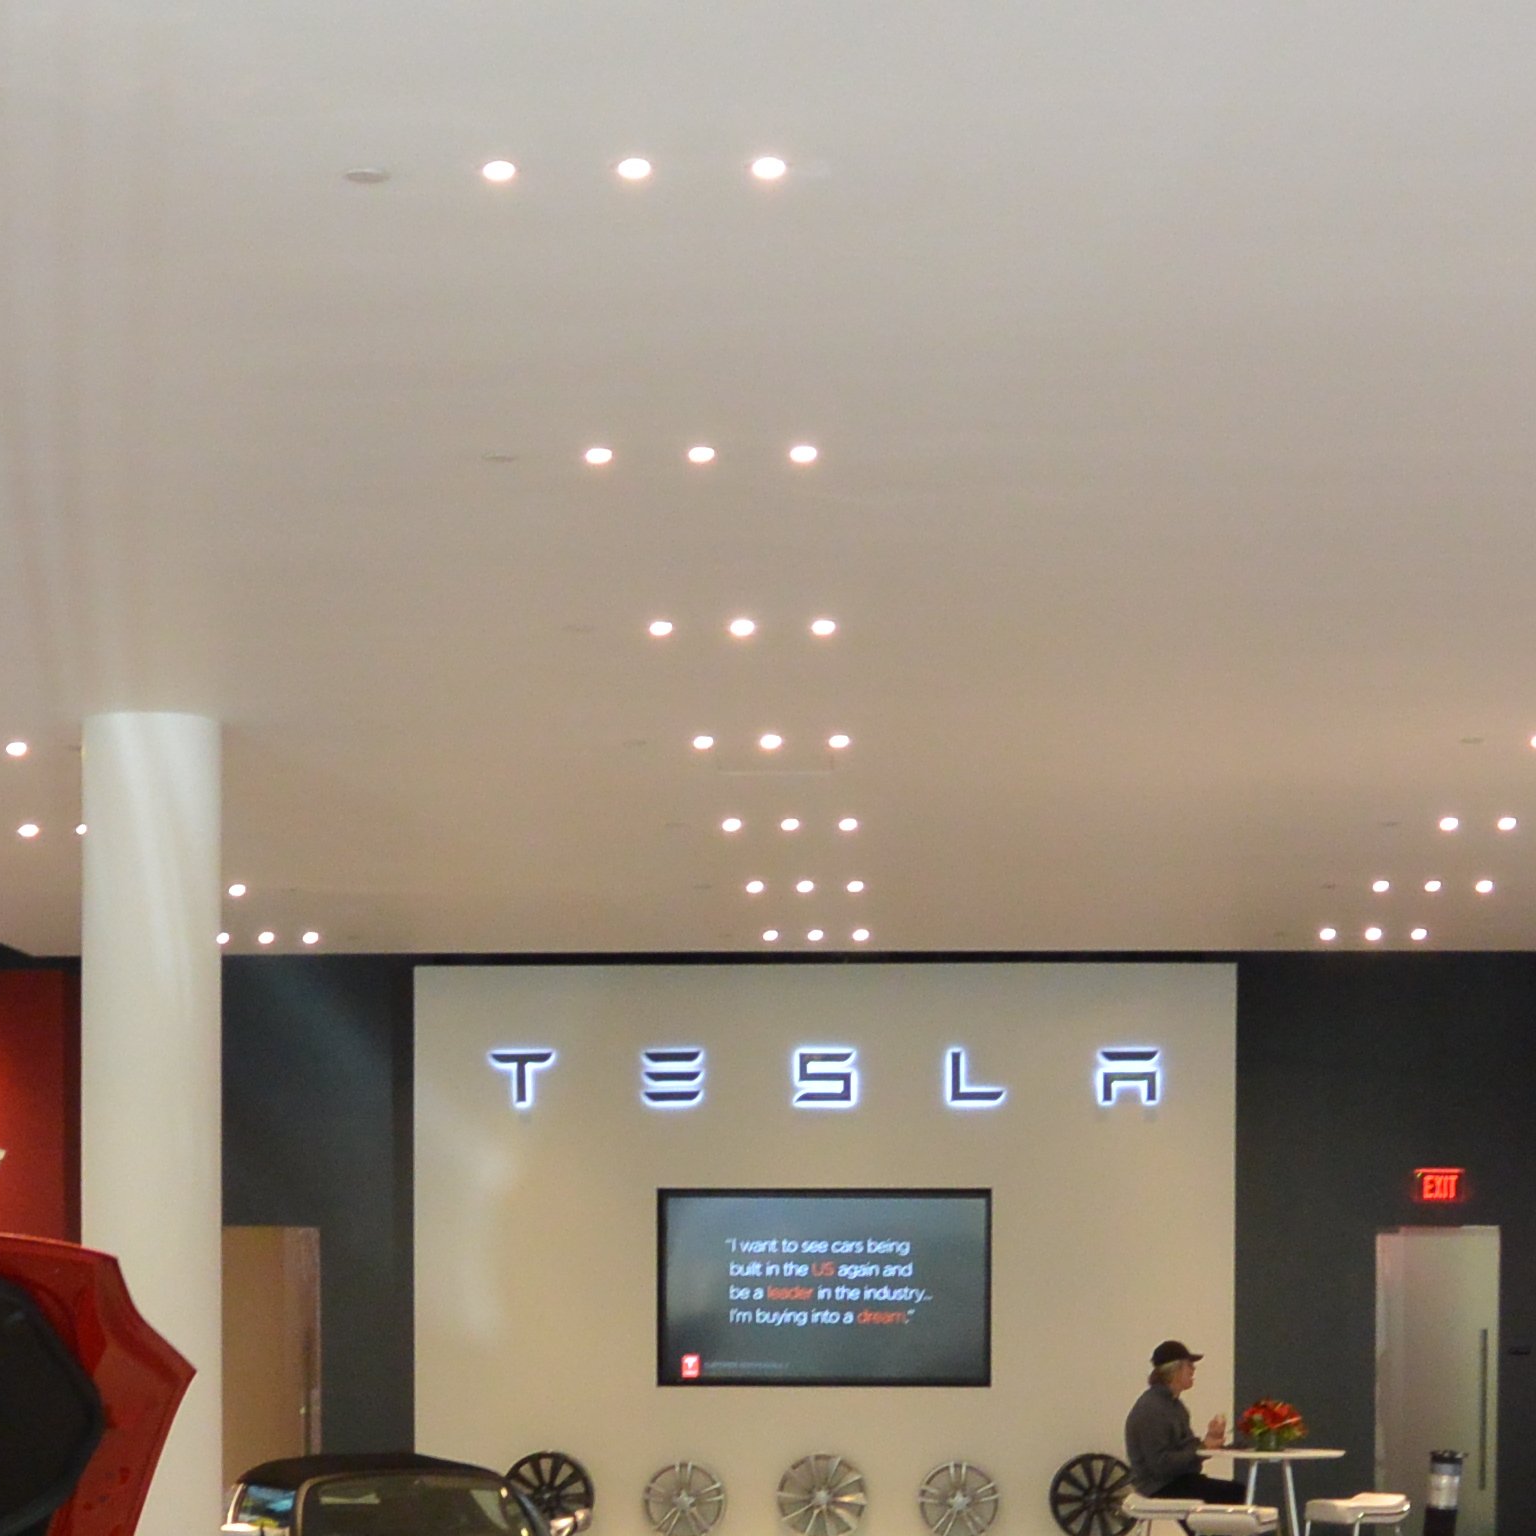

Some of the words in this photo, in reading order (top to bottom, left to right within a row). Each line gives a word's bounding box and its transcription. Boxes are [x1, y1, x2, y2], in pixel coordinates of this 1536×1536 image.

[488, 1048, 1161, 1105] TESLA
[1422, 1174, 1459, 1199] EXIT
[740, 1239, 778, 1253] want
[782, 1239, 799, 1253] to
[801, 1241, 829, 1253] see
[831, 1241, 863, 1253] cars
[867, 1238, 911, 1256] being
[729, 1261, 762, 1277] built
[766, 1261, 780, 1277] in
[783, 1261, 809, 1277] the
[811, 1261, 834, 1277] US
[838, 1262, 880, 1280] again
[882, 1262, 913, 1277] and
[729, 1285, 751, 1301] be
[753, 1288, 763, 1301] a
[767, 1285, 814, 1301] leader
[817, 1285, 832, 1301] in
[835, 1285, 861, 1301] the
[729, 1308, 752, 1324] I'm
[756, 1308, 808, 1326] buying
[811, 1308, 840, 1324] into
[842, 1312, 854, 1324] a
